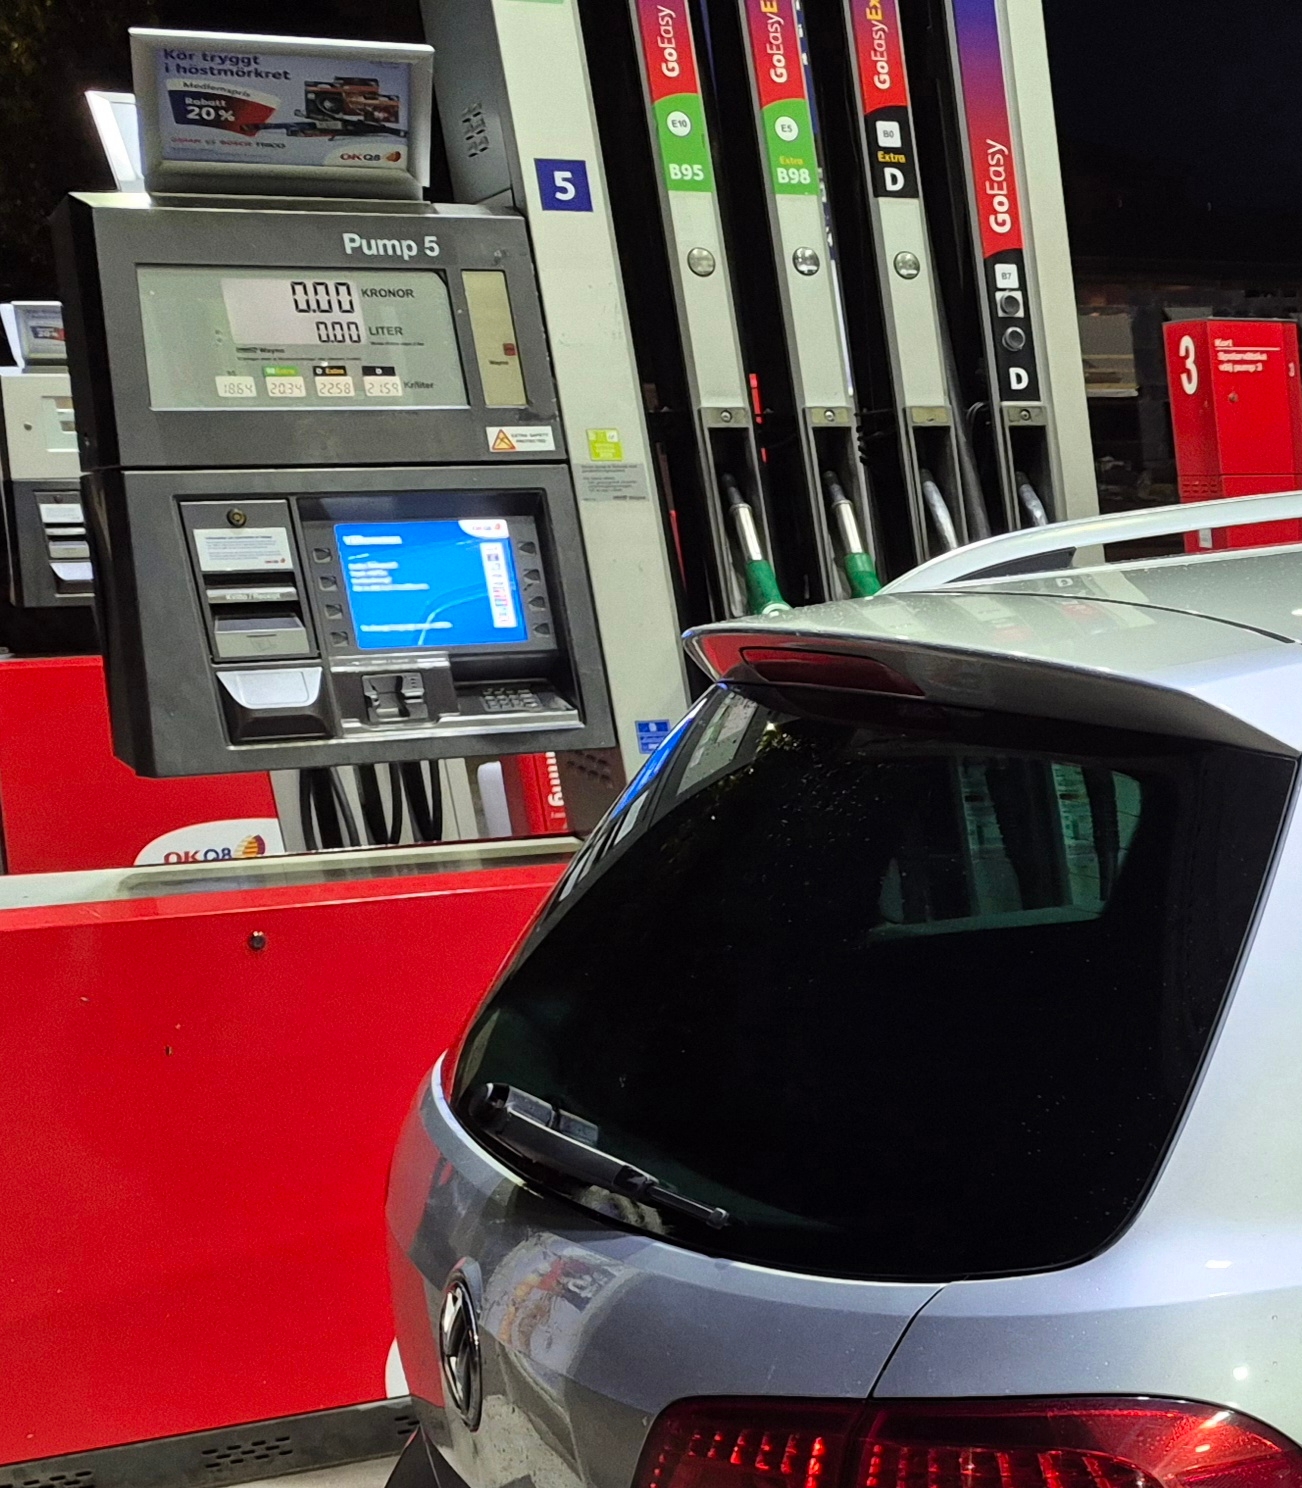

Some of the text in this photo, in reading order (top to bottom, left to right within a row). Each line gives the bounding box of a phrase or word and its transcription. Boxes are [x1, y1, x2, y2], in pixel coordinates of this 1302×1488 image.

[656, 5, 681, 78] GoEasy
[163, 48, 260, 67] Kör tryggt
[164, 62, 291, 81] i höstmörkret
[184, 97, 227, 109] Rabatt
[671, 118, 688, 129] E10
[781, 123, 794, 134] E5
[877, 150, 906, 164] Extra
[668, 163, 705, 181] B95
[776, 167, 811, 185] B98
[885, 167, 904, 192] D
[553, 171, 576, 201] 5
[984, 139, 1012, 234] GoEasy
[342, 232, 440, 261] Pump 5
[290, 281, 355, 314] 0.00
[360, 288, 415, 299] KRONOR
[315, 321, 362, 344] 0.00
[368, 326, 404, 337] LITER
[1179, 335, 1198, 395] 3
[1009, 367, 1029, 390] D
